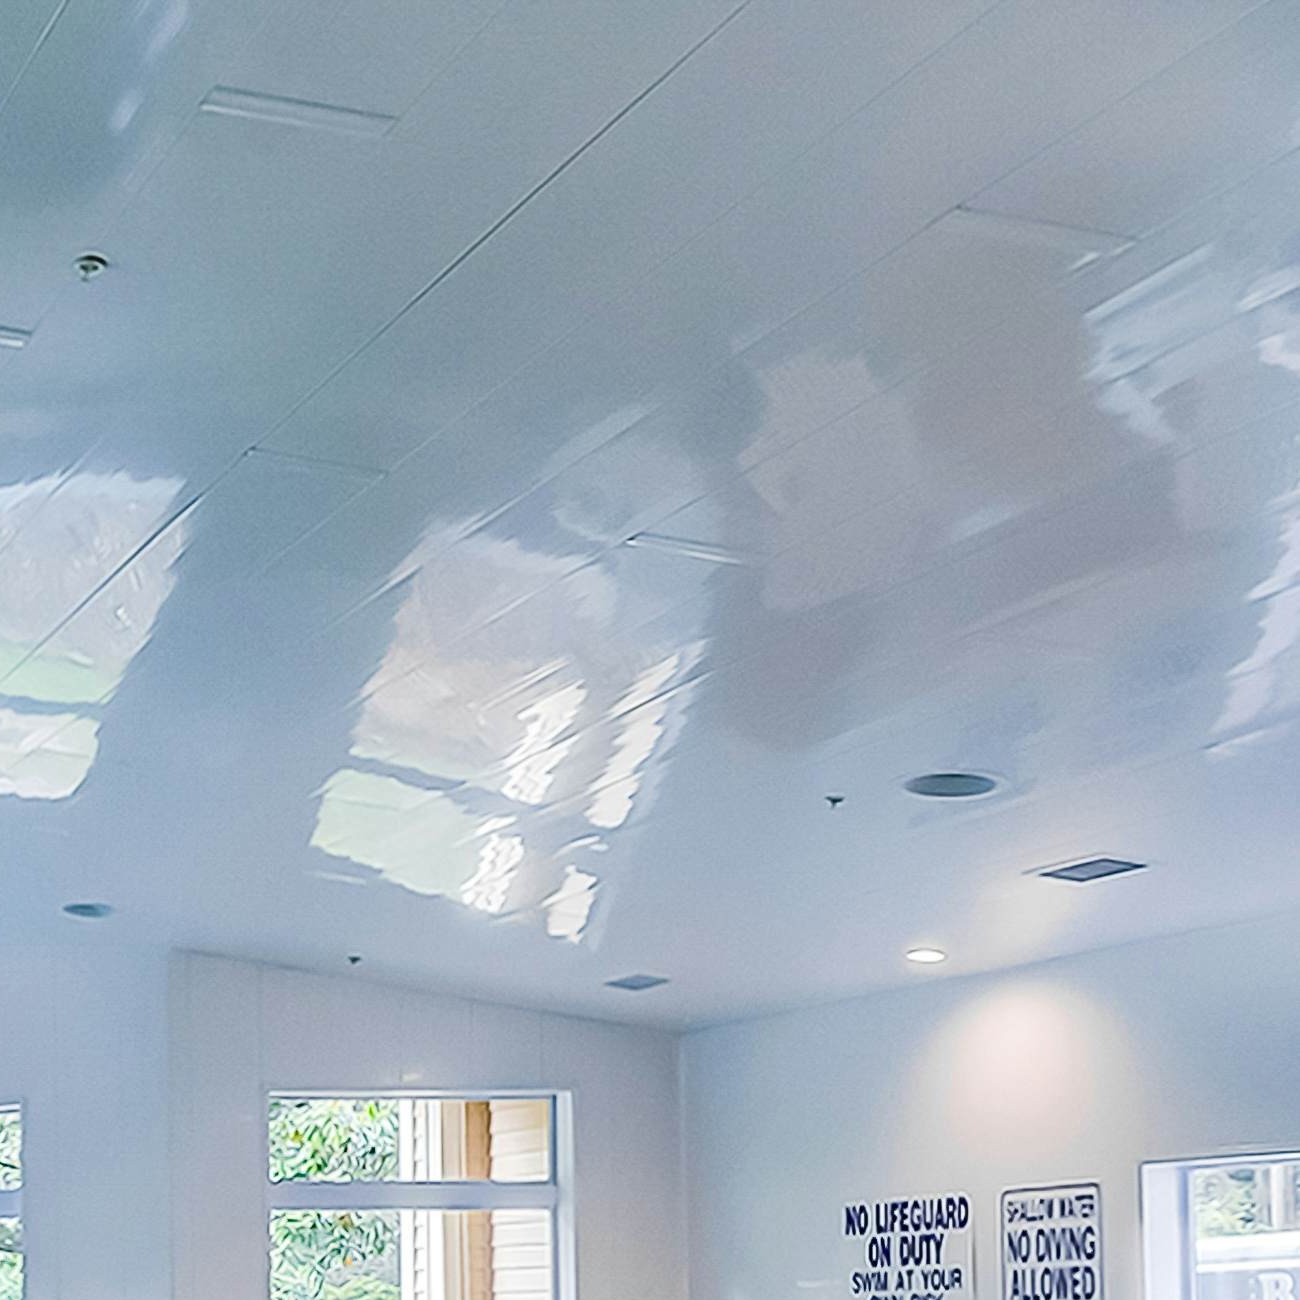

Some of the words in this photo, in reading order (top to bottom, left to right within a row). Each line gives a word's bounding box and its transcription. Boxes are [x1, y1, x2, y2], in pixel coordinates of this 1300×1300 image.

[845, 1205, 868, 1235] NO
[875, 1196, 968, 1233] LIFEGUARD
[868, 1236, 891, 1268] ON
[900, 1233, 944, 1266] DUTY
[1008, 1230, 1029, 1262] NO
[1036, 1226, 1095, 1261] DIVING
[852, 1271, 888, 1294] SWIM
[895, 1269, 914, 1291] AT
[921, 1268, 962, 1290] YOUR
[1010, 1266, 1096, 1300] ALLOWED
